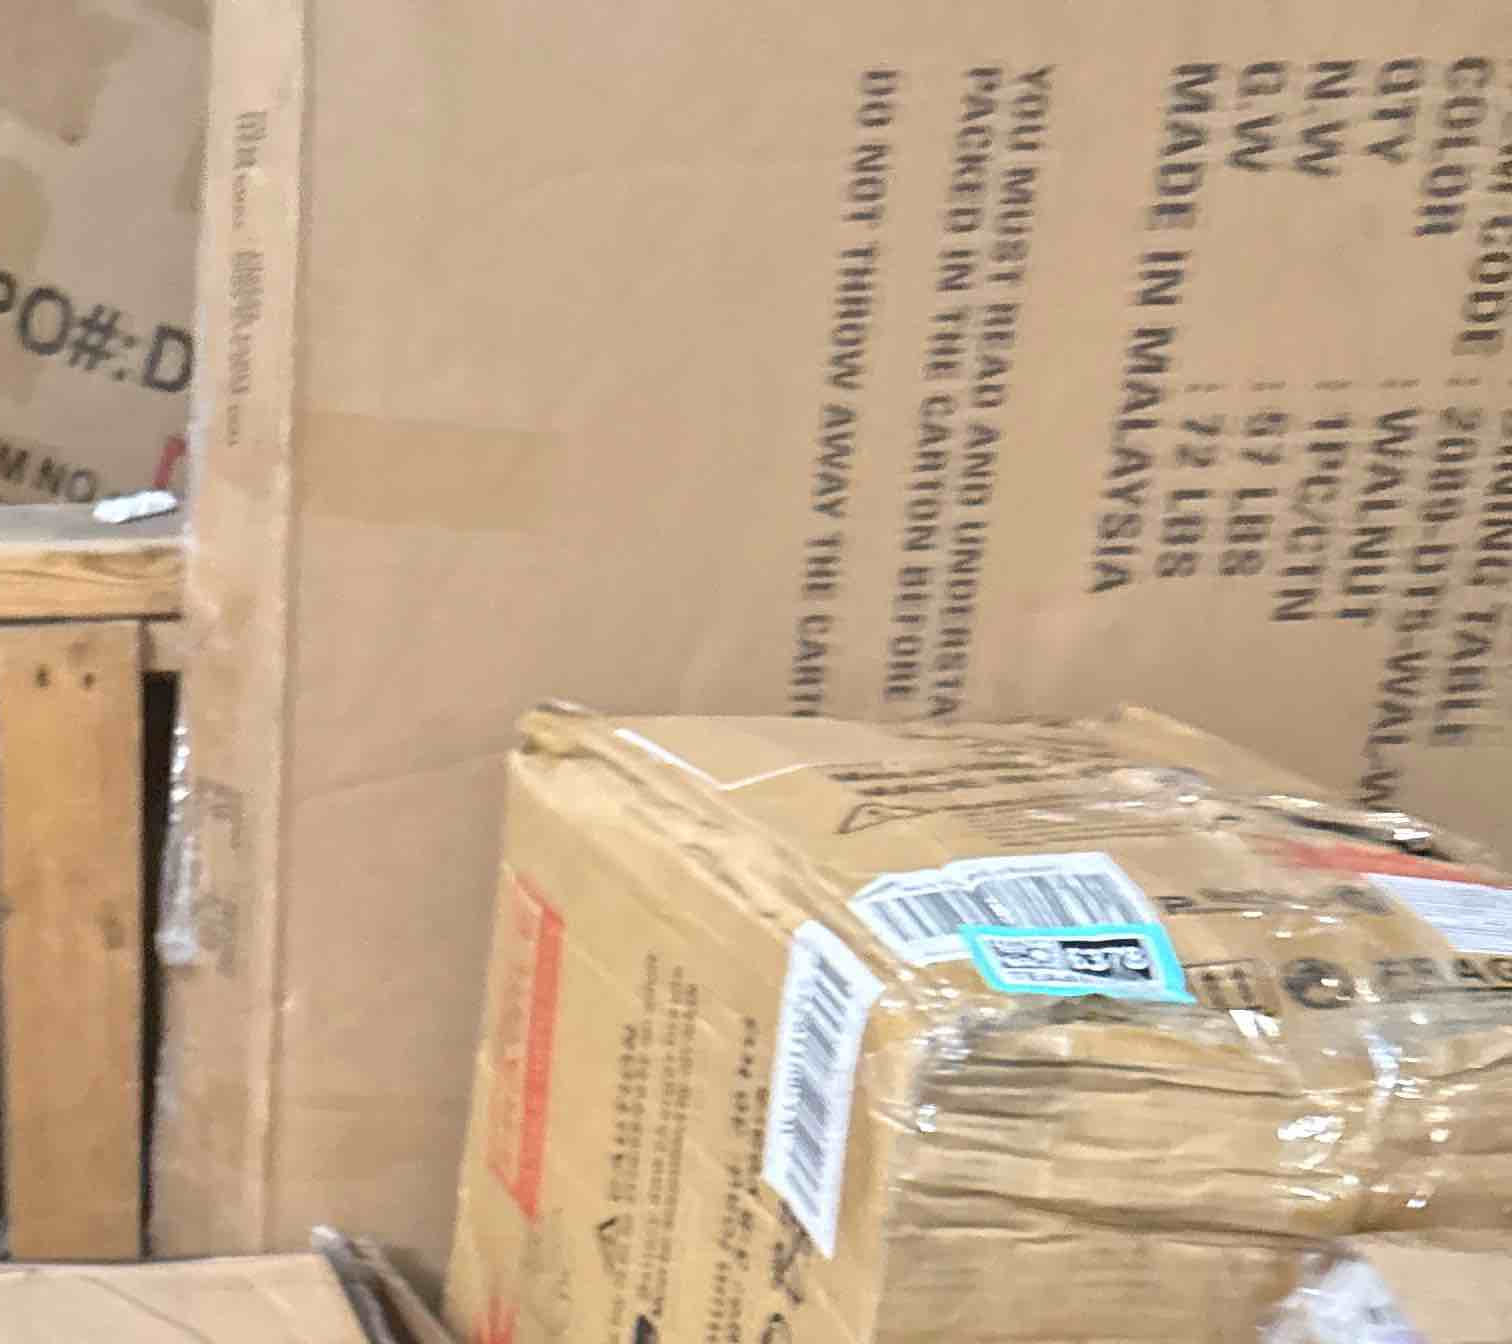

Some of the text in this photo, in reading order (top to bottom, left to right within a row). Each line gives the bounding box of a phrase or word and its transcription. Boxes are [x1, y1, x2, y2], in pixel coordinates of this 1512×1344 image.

[857, 68, 900, 128] DO
[1006, 63, 1056, 151] YOU
[1361, 56, 1424, 164] QTY
[841, 143, 892, 228] NOT
[986, 167, 1038, 285] MUST
[824, 241, 879, 391] THROW
[970, 302, 1020, 408] READ
[1088, 61, 1221, 593] MADE IN MALAYSIA
[1336, 55, 1493, 627] COLOR WALNUT
[880, 66, 1003, 703] PACKED IN THE CARTON BEFORE
[810, 403, 858, 518] AWAY
[956, 423, 1003, 506] AND
[801, 531, 842, 600] THE
[1155, 487, 1213, 579] LBS
[1218, 486, 1279, 578] LBS
[1431, 603, 1504, 747] TABLE
